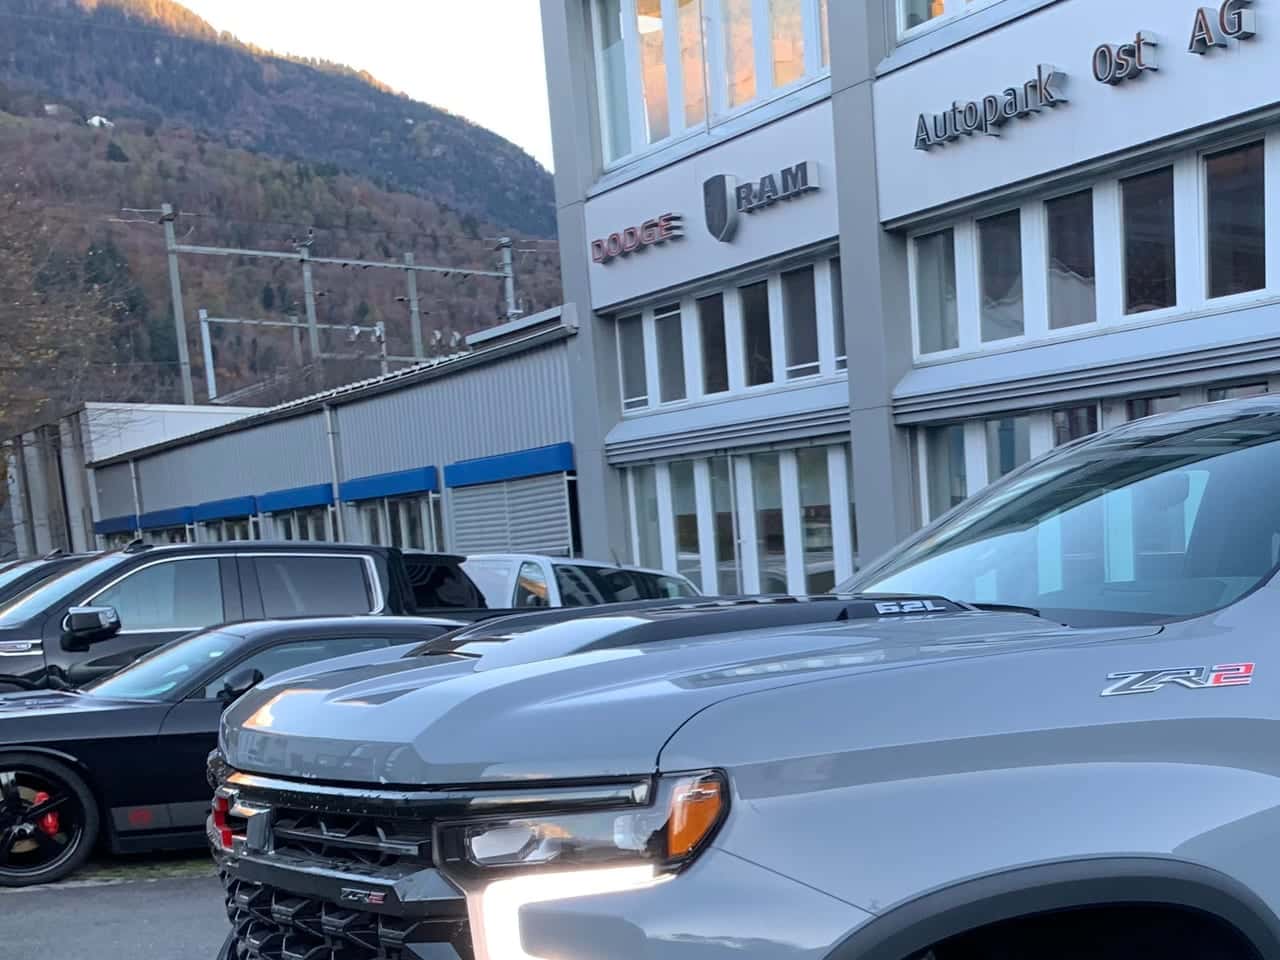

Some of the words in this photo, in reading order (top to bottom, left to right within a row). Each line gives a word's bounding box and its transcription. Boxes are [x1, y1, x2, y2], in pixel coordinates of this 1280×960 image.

[914, 64, 1064, 150] Autopark
[1091, 30, 1157, 84] Ost
[1188, 0, 1254, 54] AG
[736, 160, 818, 213] RAM
[591, 212, 682, 264] DODGE
[1100, 662, 1255, 697] ZR2
